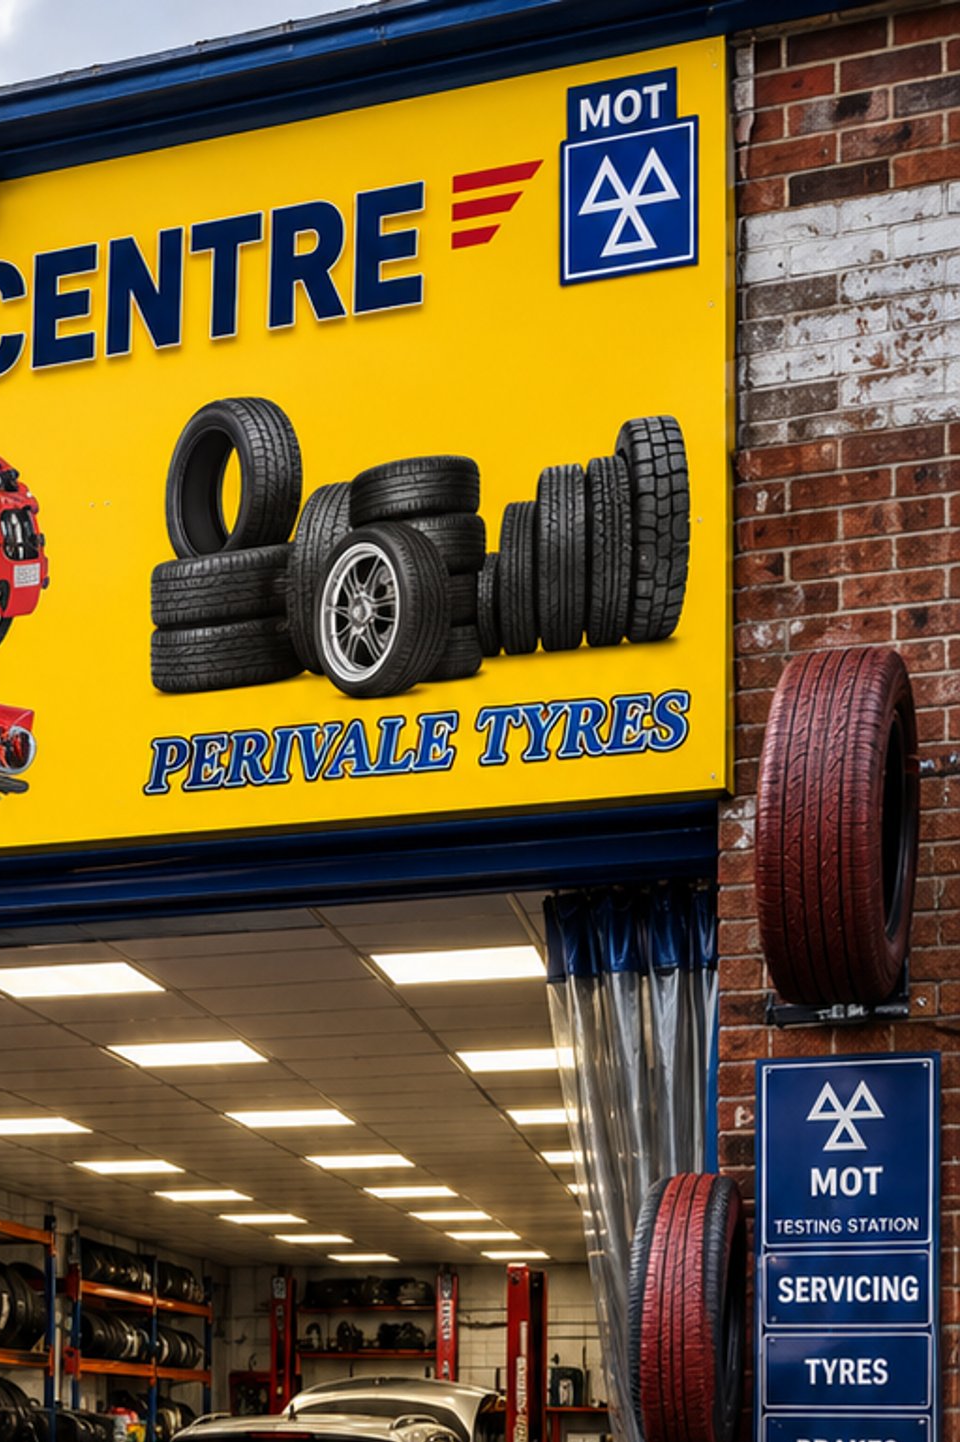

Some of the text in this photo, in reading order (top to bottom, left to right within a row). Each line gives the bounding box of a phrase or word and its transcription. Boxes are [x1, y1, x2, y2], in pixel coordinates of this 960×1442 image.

[579, 82, 669, 132] MOT
[143, 690, 691, 795] PERIVALE TYRES
[810, 1166, 884, 1197] MOT
[774, 1217, 920, 1234] TESTING STATION
[777, 1275, 919, 1303] SERVICING
[804, 1358, 889, 1386] TYRES
